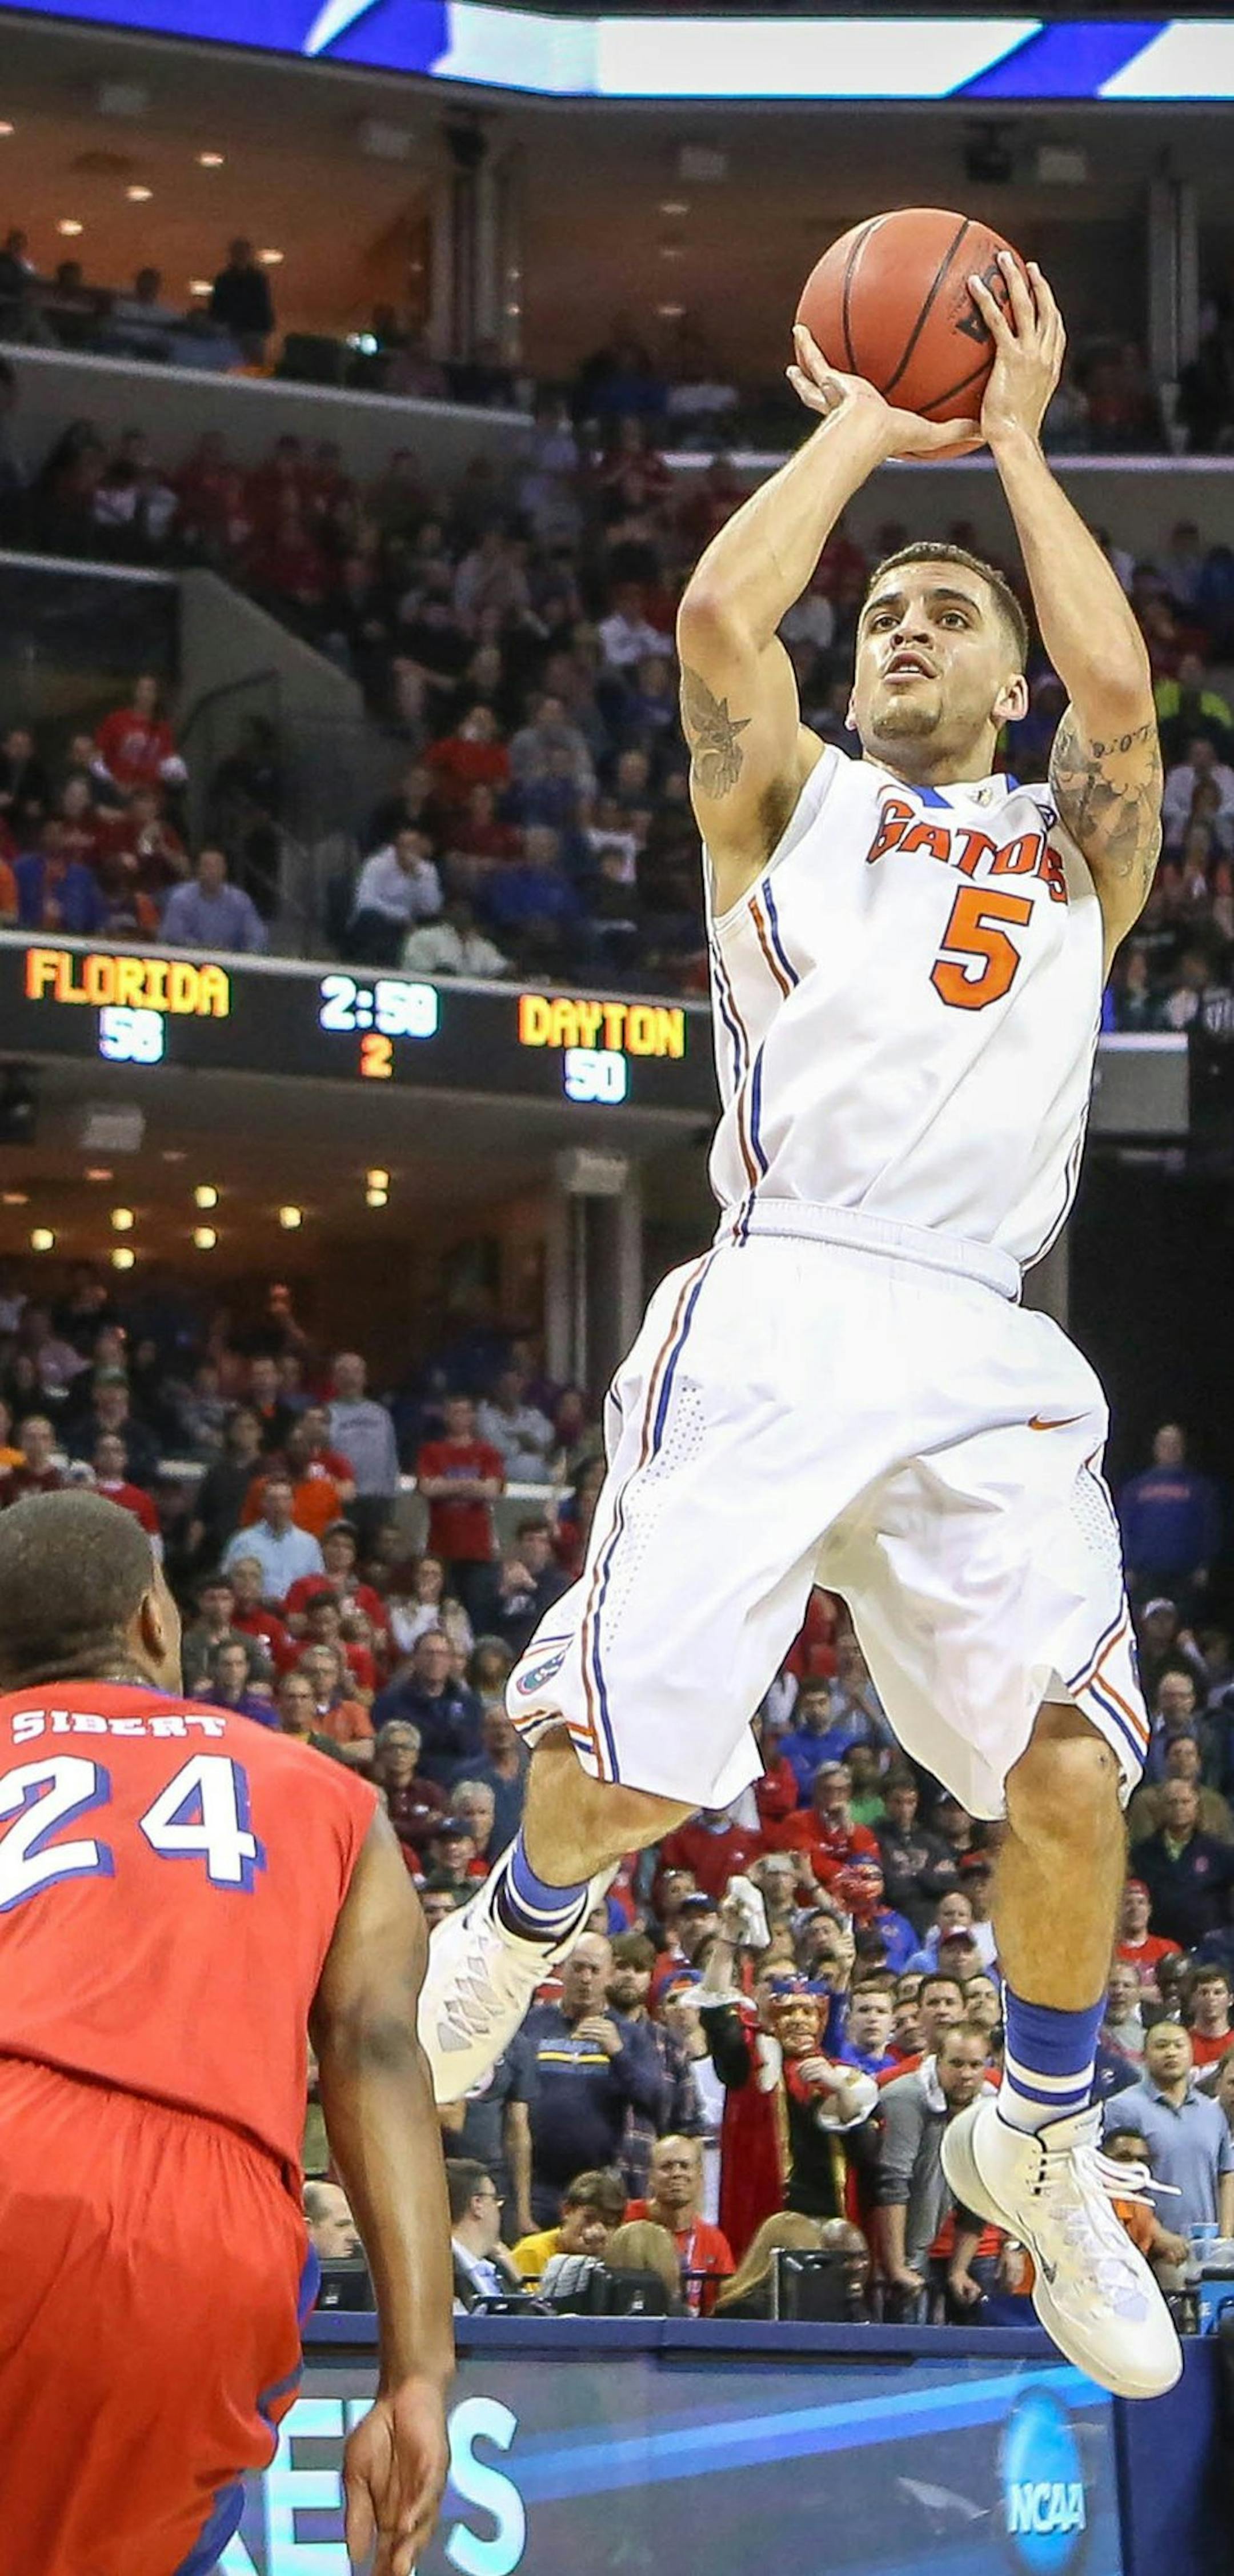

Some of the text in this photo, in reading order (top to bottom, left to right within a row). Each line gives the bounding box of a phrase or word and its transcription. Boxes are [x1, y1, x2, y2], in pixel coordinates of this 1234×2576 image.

[929, 884, 1035, 1011] 5
[25, 947, 230, 1017] FLORIDA
[360, 1032, 394, 1079] 2
[518, 993, 685, 1058] DAYTON
[563, 1048, 628, 1105] 50
[12, 1709, 227, 1745] SIBERT
[0, 1752, 267, 1913] 24
[1008, 2482, 1085, 2535] NCAA
